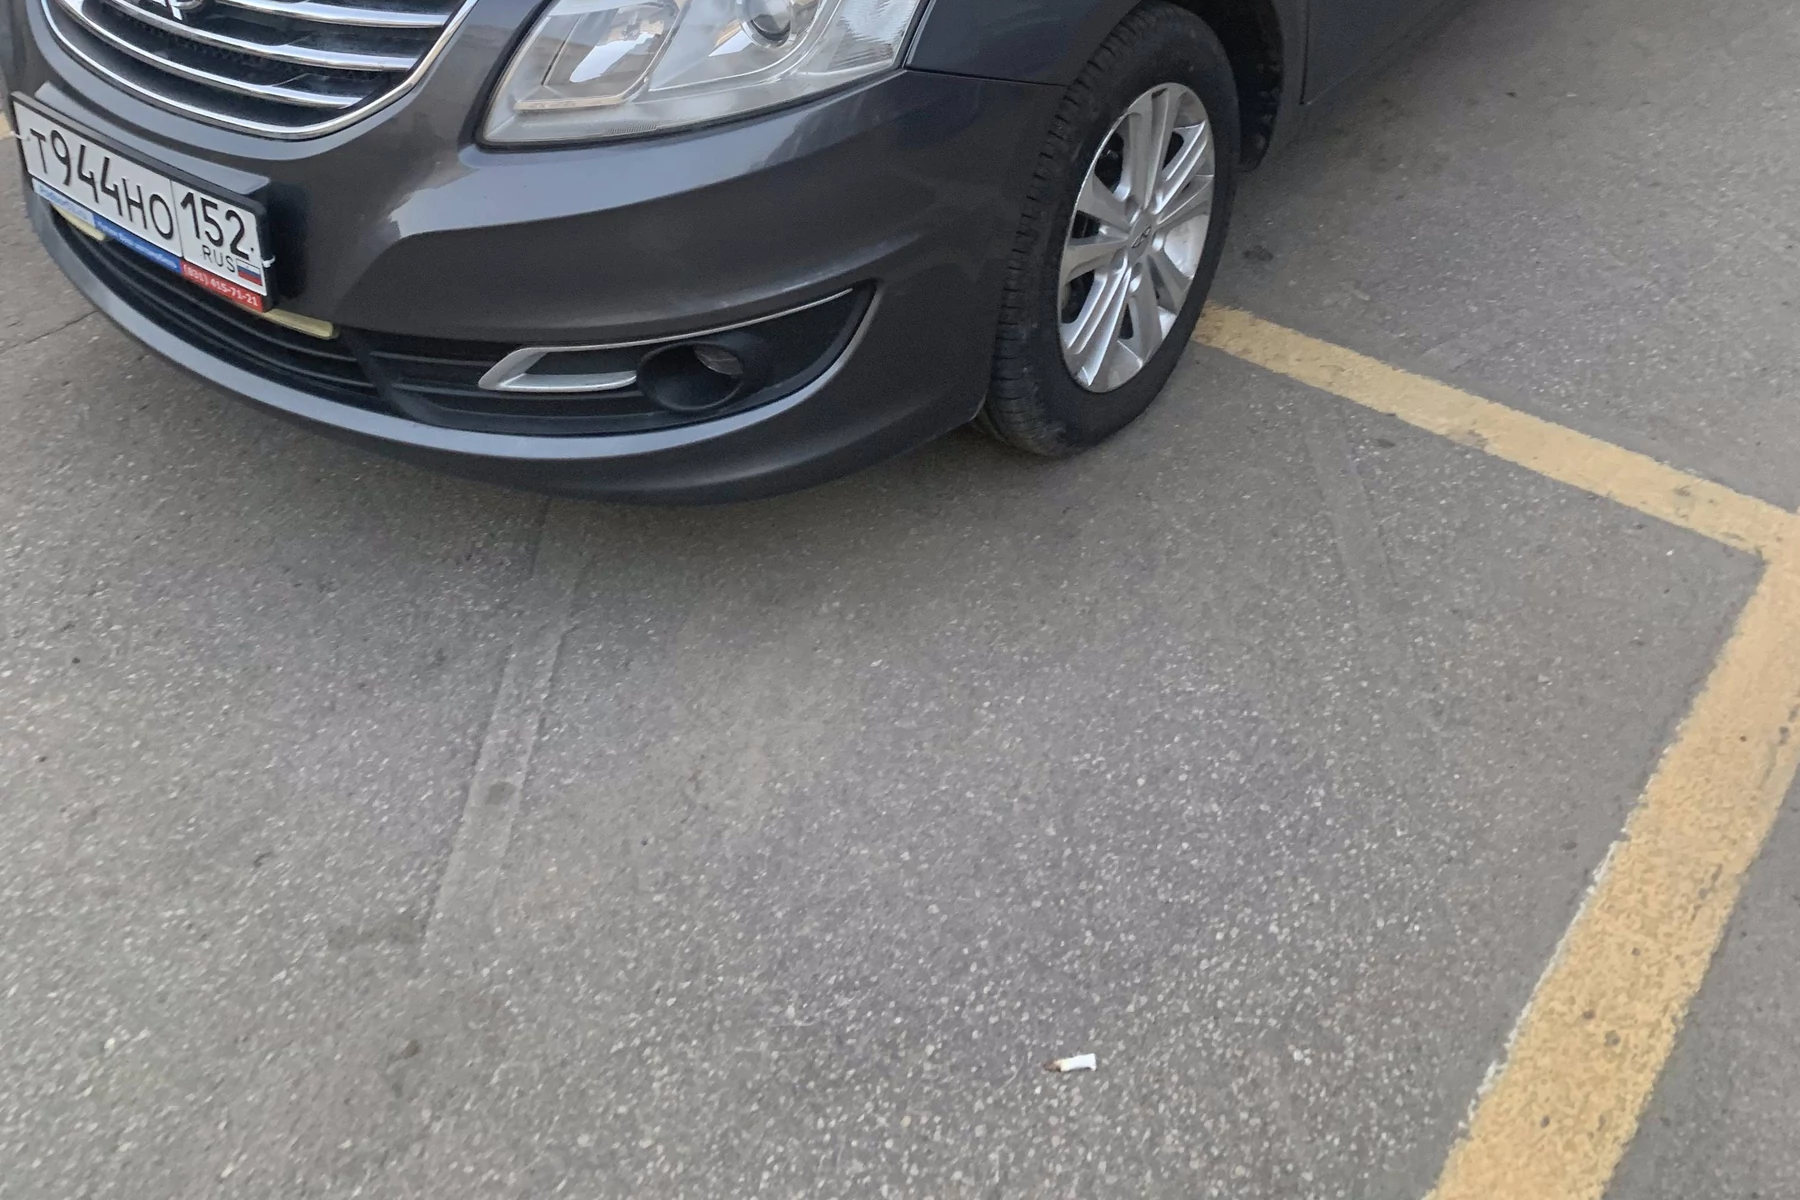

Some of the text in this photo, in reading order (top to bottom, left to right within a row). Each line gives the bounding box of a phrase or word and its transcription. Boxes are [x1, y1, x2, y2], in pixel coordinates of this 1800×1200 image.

[30, 128, 174, 240] Т944НО
[180, 191, 250, 260] 152
[202, 244, 236, 273] RUS
